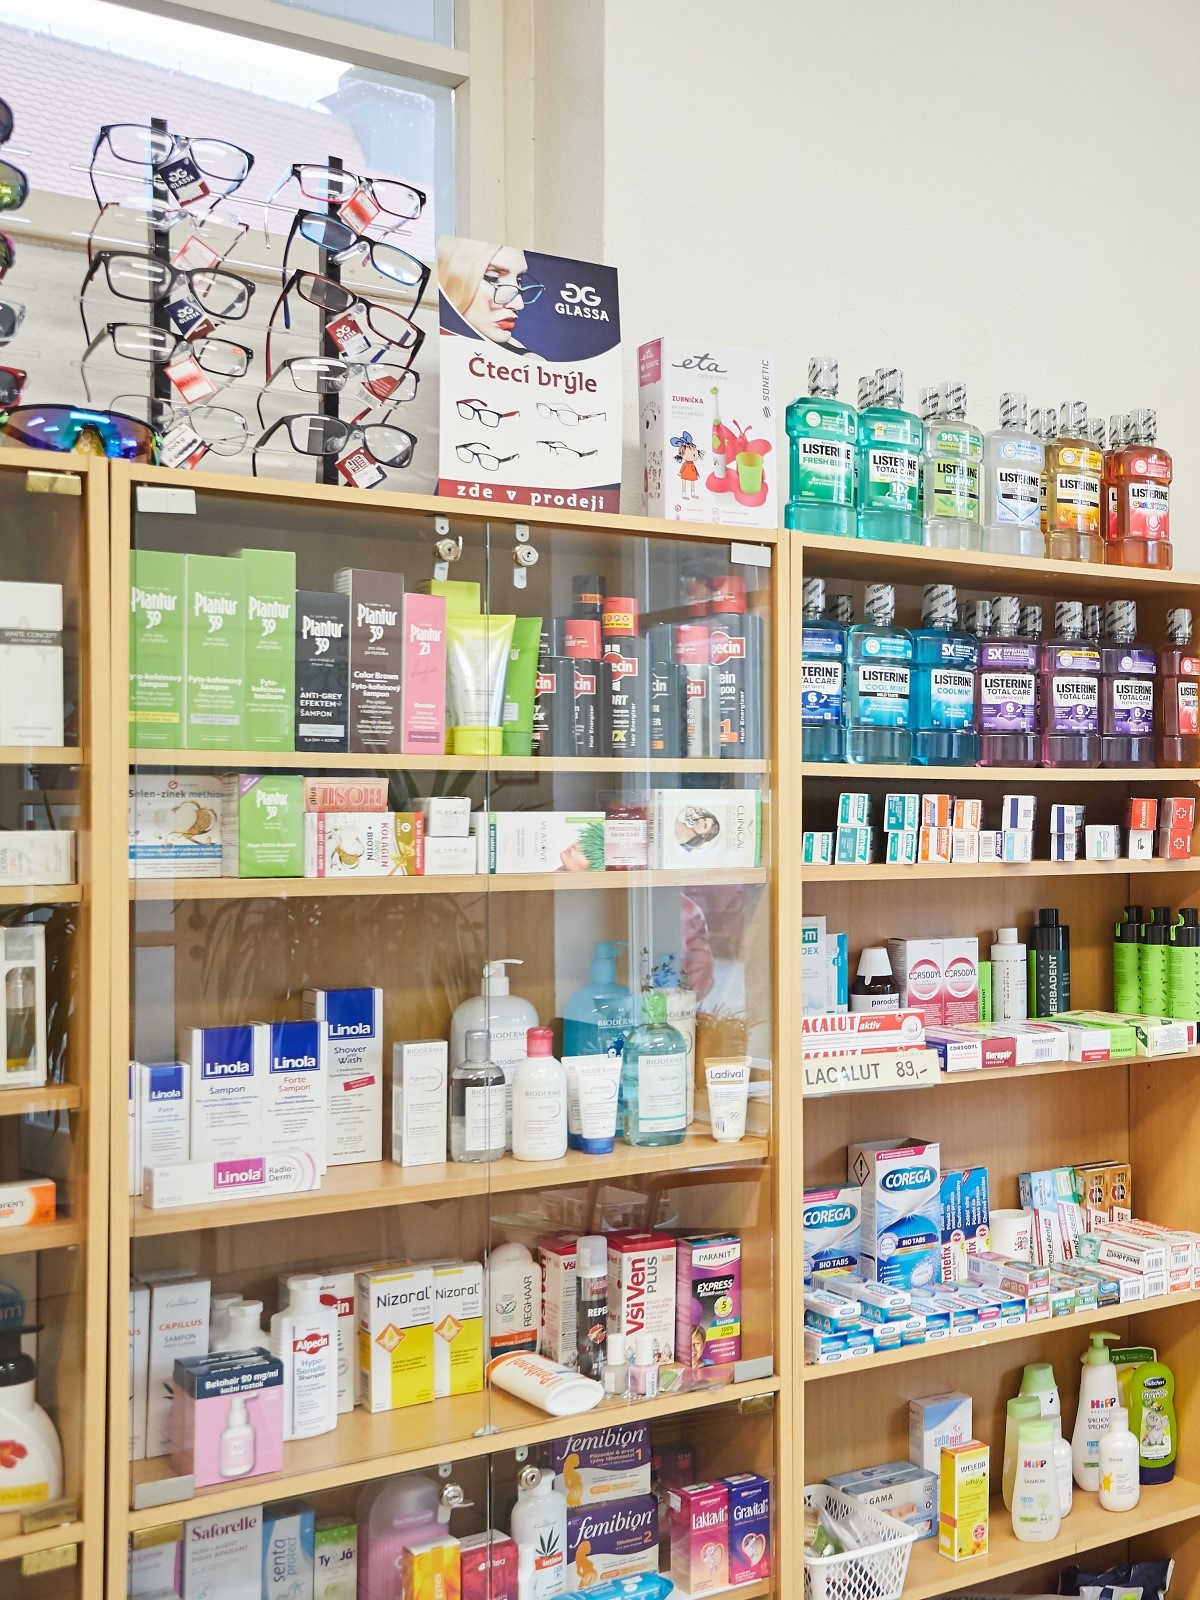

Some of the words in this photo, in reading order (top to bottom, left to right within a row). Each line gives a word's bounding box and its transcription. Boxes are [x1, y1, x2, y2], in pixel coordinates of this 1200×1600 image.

[169, 172, 196, 190] GLASSA
[177, 310, 200, 326] GLASSA
[555, 303, 609, 322] GLASSA
[672, 353, 727, 373] eta
[468, 353, 529, 384] Čtecí
[538, 365, 597, 394] brýle
[762, 360, 770, 401] SONETIC
[672, 395, 704, 404] ZUBNIČKA
[803, 443, 850, 459] LISTERINE
[873, 454, 917, 470] LISTERINE
[1000, 472, 1039, 487] LISTERINE
[1060, 479, 1098, 493] LISTERINE
[457, 484, 493, 499] zde
[507, 490, 517, 501] v
[531, 492, 605, 512] prodeji
[1132, 488, 1168, 500] LISTERINE
[131, 587, 177, 610] Plantur
[194, 592, 238, 616] Plantur
[248, 597, 290, 619] Plantur
[357, 603, 397, 627] Plantur
[302, 615, 343, 639] Plantur
[410, 624, 441, 642] Plantur
[862, 671, 908, 683] LISTERINE
[935, 675, 972, 687] LISTERINE
[985, 679, 1032, 689] LISTERINE
[301, 692, 342, 700] ANTI-GREY
[1057, 684, 1096, 694] LISTERINE
[1116, 684, 1151, 694] LISTERINE
[300, 709, 332, 717] ŠAMPON
[330, 1024, 370, 1036] Linola
[859, 1022, 881, 1030] aktiv
[334, 1046, 366, 1054] Shower
[274, 1056, 315, 1069] Linola
[338, 1056, 362, 1064] Wash
[206, 1063, 249, 1075] Linola
[710, 1069, 744, 1079] Ladival
[805, 1063, 879, 1085] LACALUT
[896, 1061, 927, 1079] 89,-
[284, 1076, 306, 1084] Forte
[152, 1090, 180, 1099] Linola
[218, 1170, 261, 1184] Linola
[269, 1173, 291, 1181] Derm
[886, 1171, 930, 1188] COREGA
[804, 1207, 851, 1225] COREGA
[902, 1237, 912, 1245] BIO
[698, 1251, 732, 1262] PARANIT
[819, 1261, 831, 1269] BIO
[833, 1258, 849, 1267] TABS
[648, 1256, 657, 1293] PLUS
[697, 1278, 733, 1296] EXPRESS
[377, 1288, 430, 1308] Nizoral
[524, 1276, 532, 1327] REGHAAR
[626, 1258, 645, 1337] VšiVen
[159, 1319, 203, 1330] CAPILLUS
[295, 1336, 328, 1351] Alpecin
[206, 1379, 239, 1389] Belohair
[242, 1374, 251, 1384] 20
[253, 1369, 278, 1383] mg/ml
[221, 1385, 240, 1395] kožní
[242, 1380, 264, 1390] roztok
[1090, 1397, 1116, 1409] HiPP
[961, 1461, 986, 1473] WELEDA
[1024, 1459, 1047, 1468] HiPP
[869, 1494, 893, 1505] GAMA
[192, 1516, 257, 1541] Saforelle
[570, 1510, 652, 1548] femibion
[318, 1554, 330, 1567] Ty
[340, 1548, 352, 1561] Já
